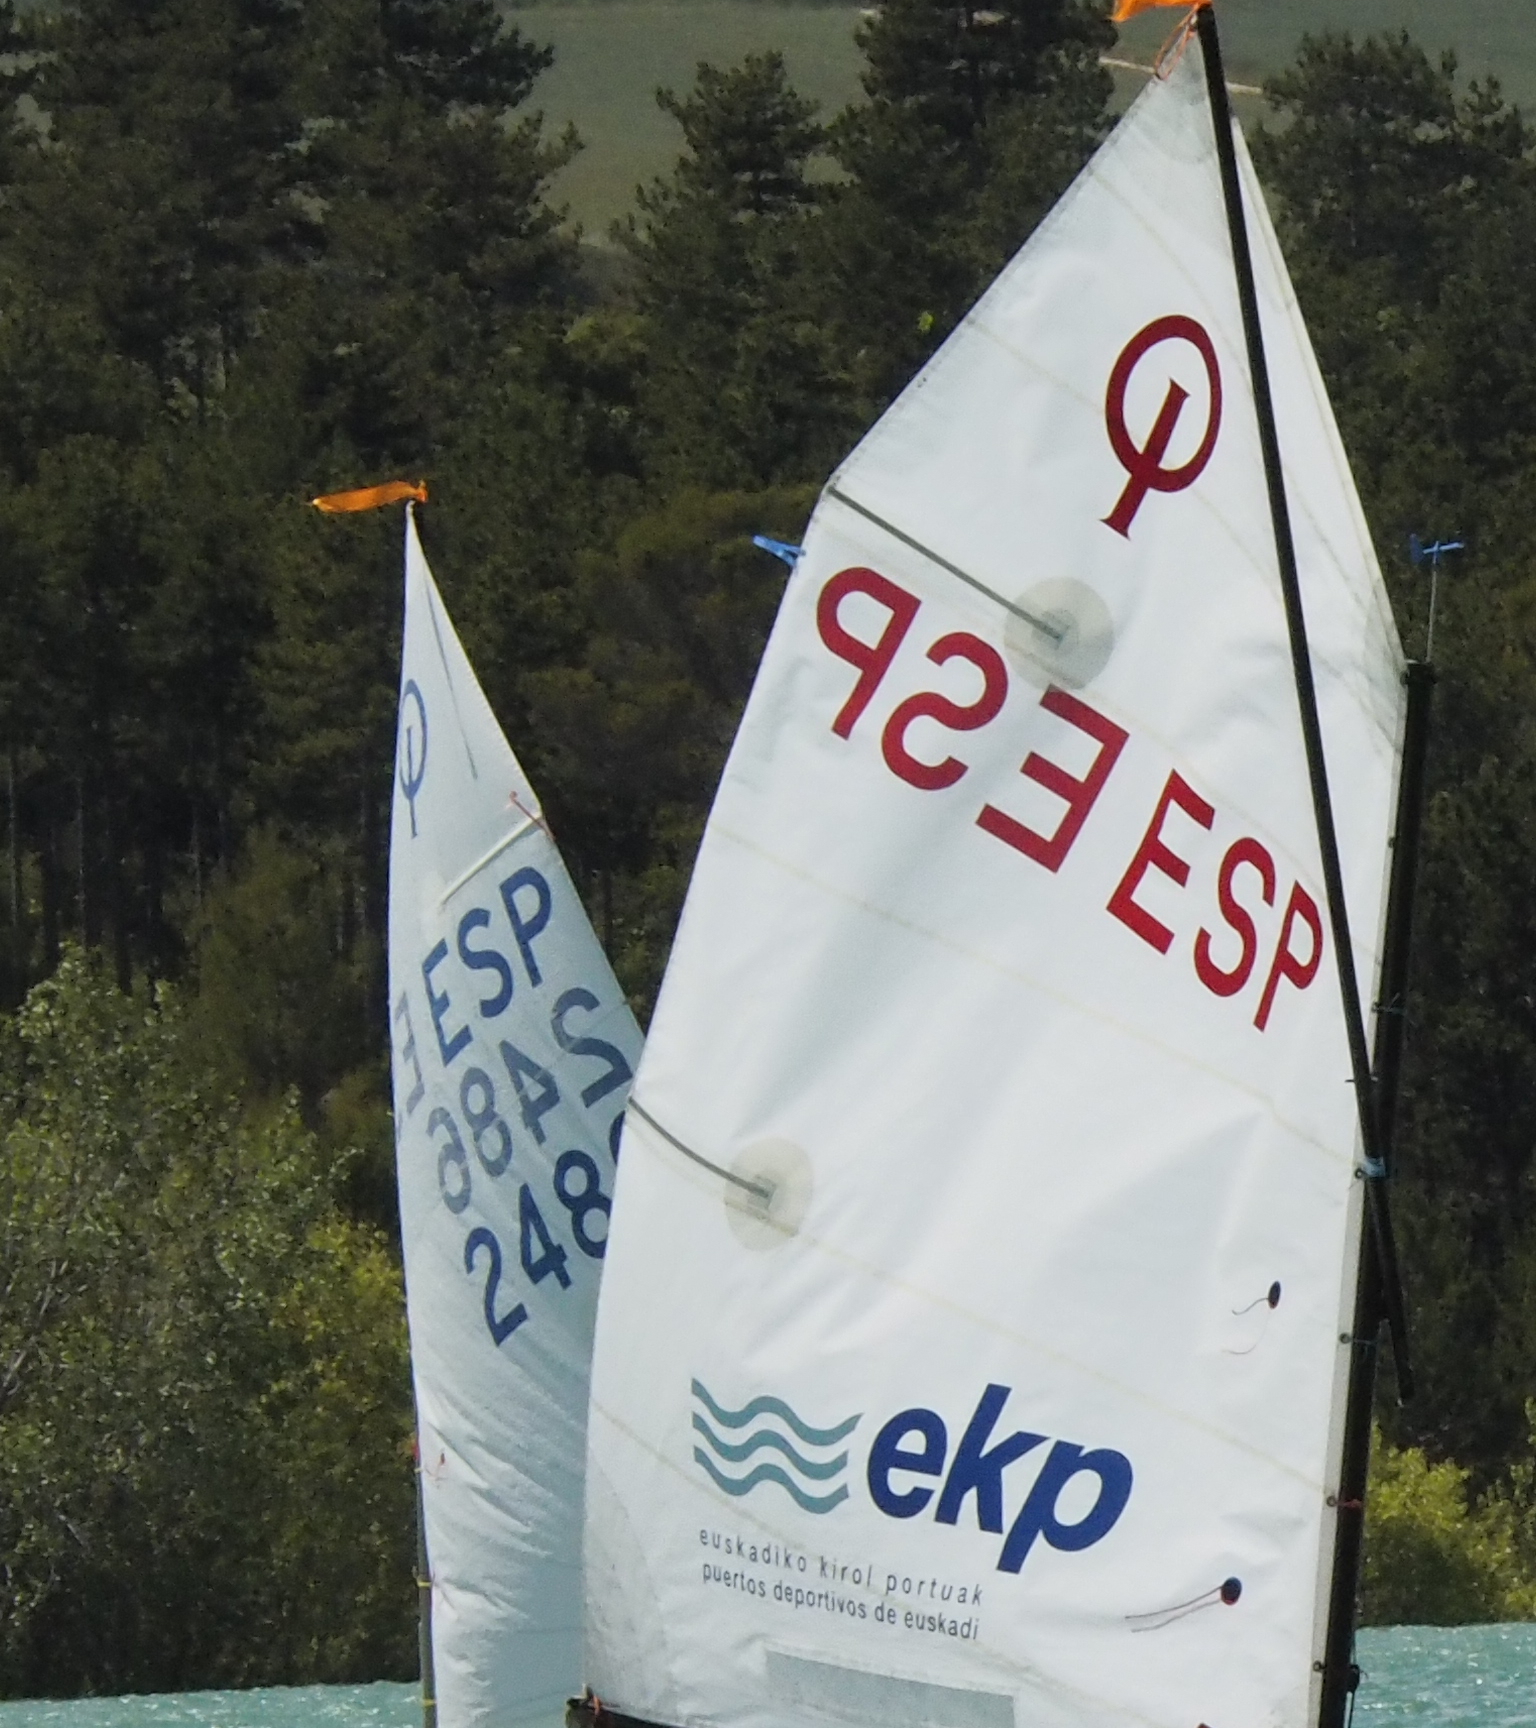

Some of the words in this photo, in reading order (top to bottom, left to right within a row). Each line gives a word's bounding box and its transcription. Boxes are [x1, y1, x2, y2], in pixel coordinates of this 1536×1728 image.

[421, 867, 552, 1067] ESP
[1105, 768, 1323, 1032] ESP
[464, 1110, 626, 1347] 248
[700, 1528, 807, 1572] euskadiko
[820, 1555, 872, 1587] kirol
[886, 1573, 983, 1606] portuak
[867, 1383, 1133, 1574] ekp
[703, 1562, 766, 1598] puertos
[773, 1579, 867, 1619] deportivos
[874, 1603, 897, 1625] de
[904, 1610, 980, 1640] euskadi
